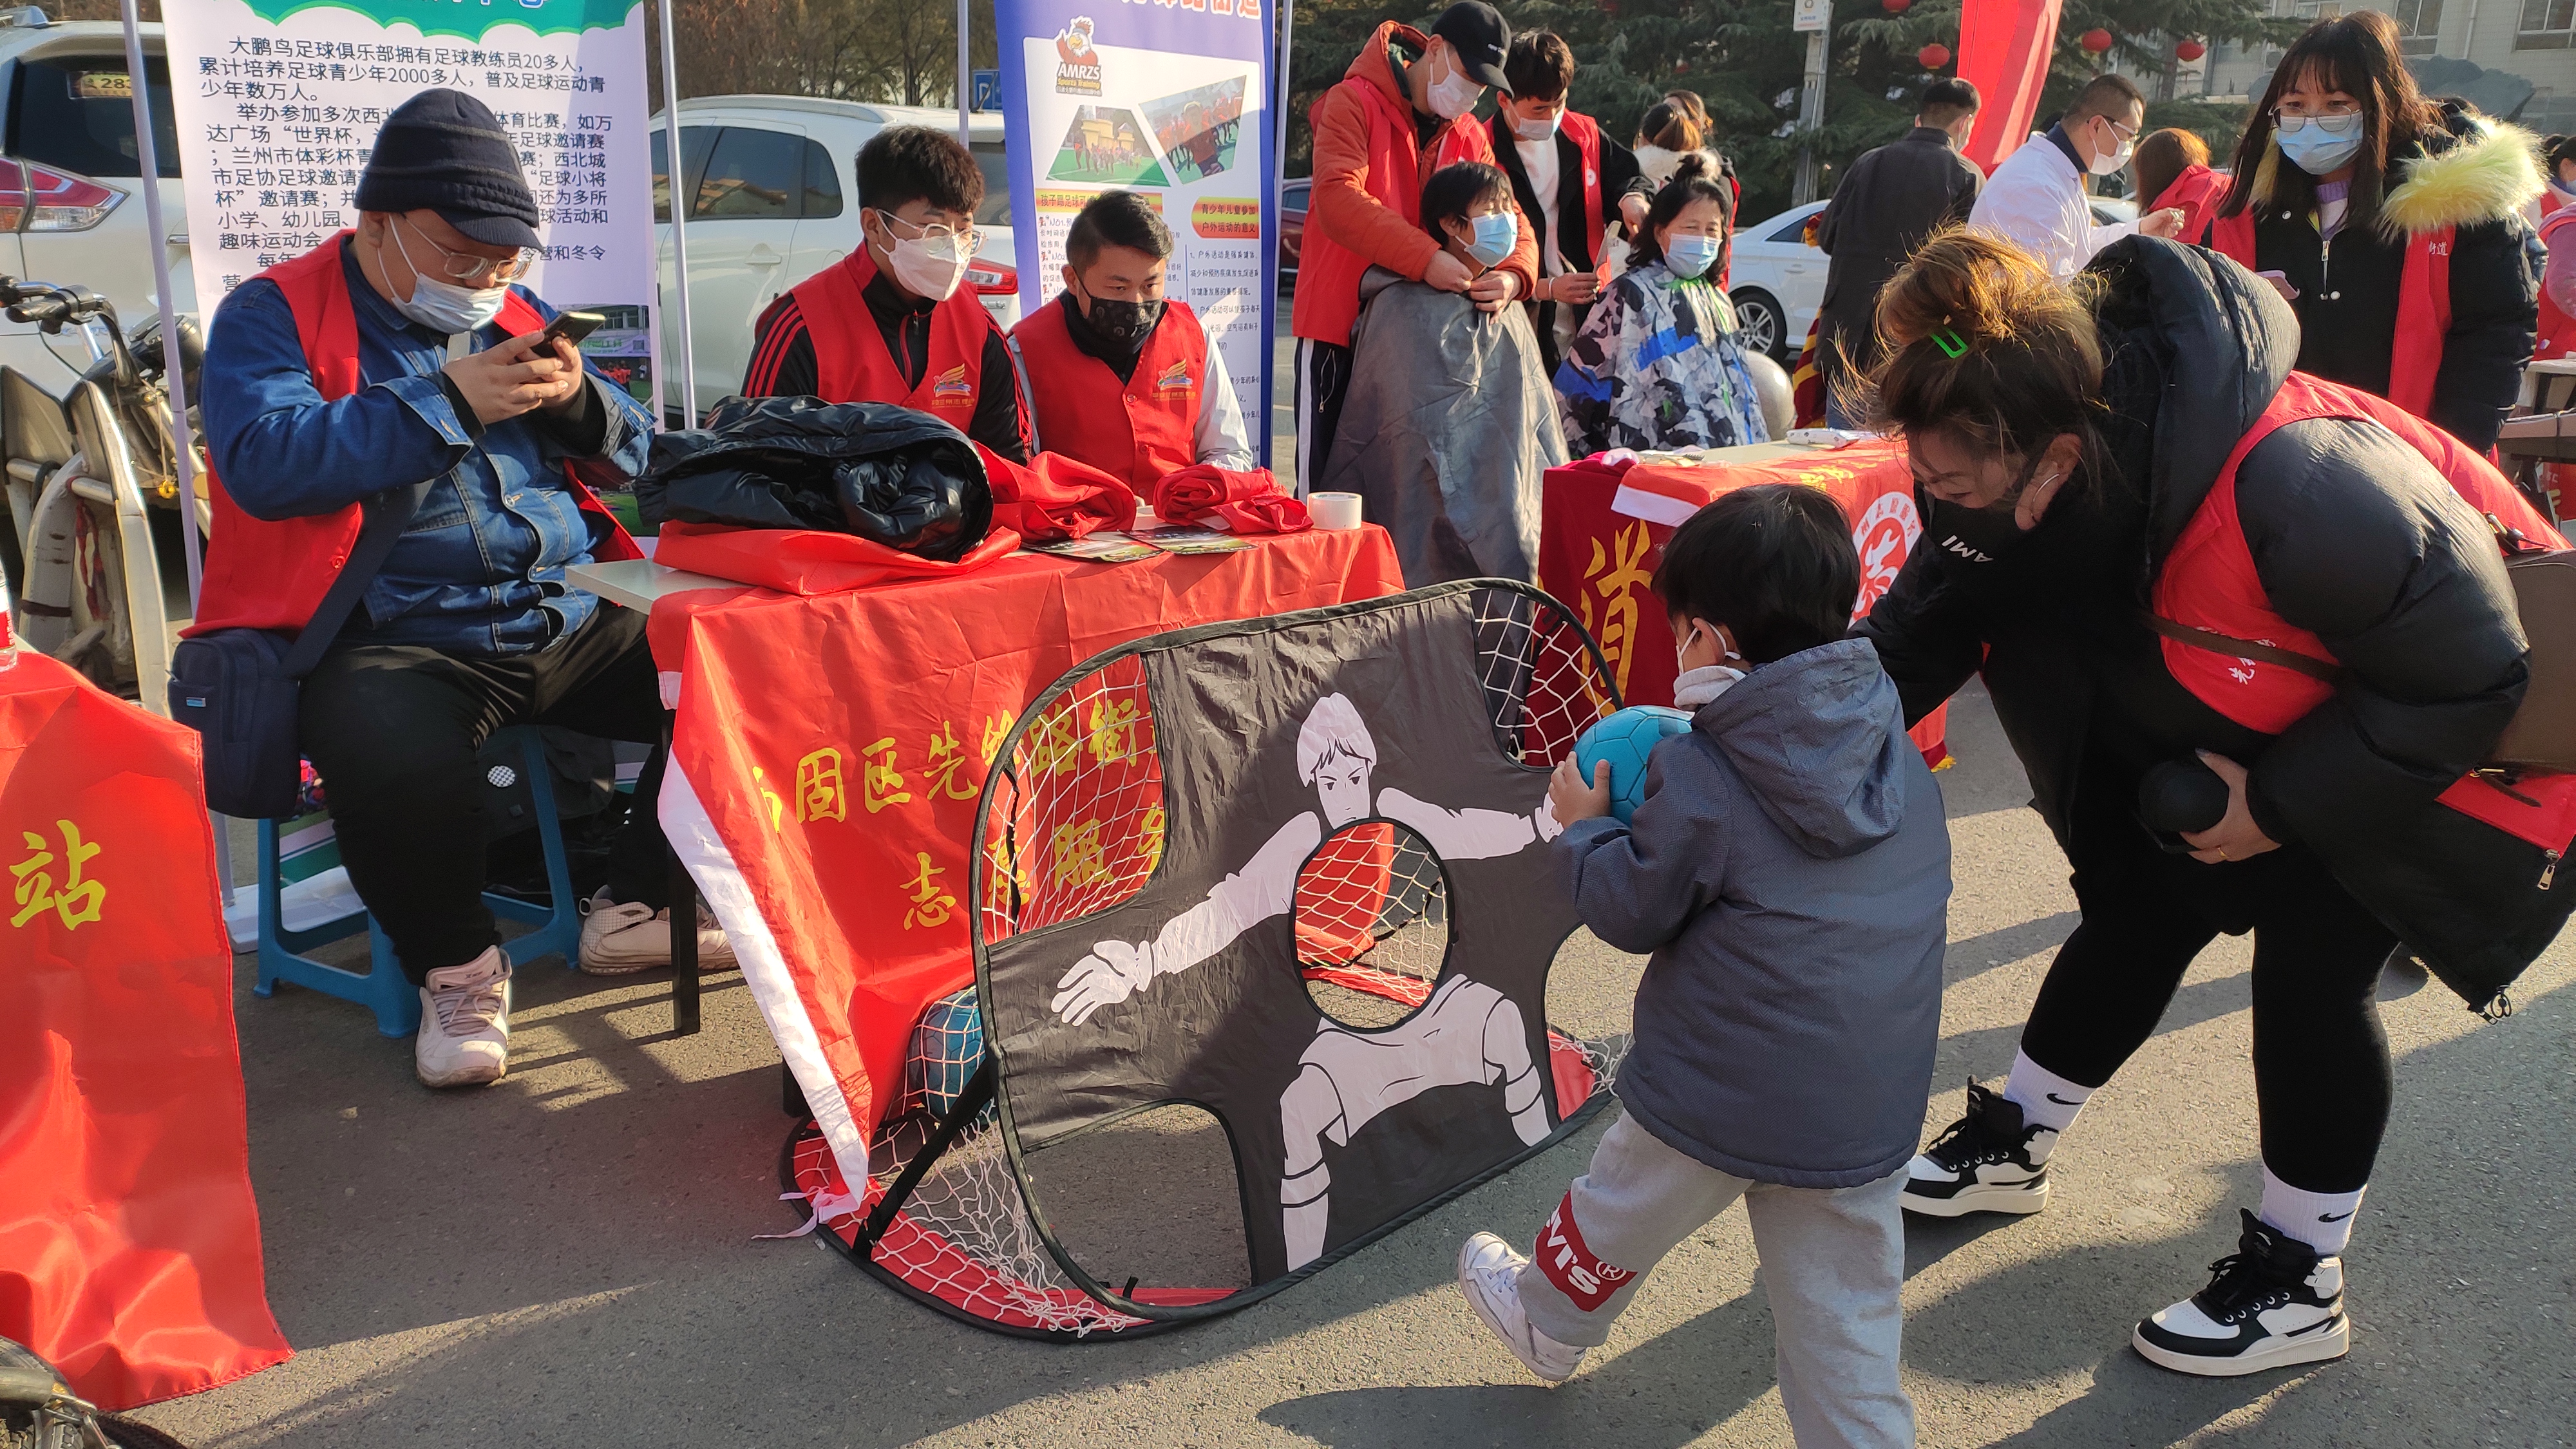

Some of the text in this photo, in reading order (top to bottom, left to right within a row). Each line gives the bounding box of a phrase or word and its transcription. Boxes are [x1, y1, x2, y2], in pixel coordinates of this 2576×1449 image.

[1057, 62, 1101, 80] AMRZS
[201, 79, 317, 102] 少年数万人。
[219, 231, 321, 250] 趣味运动会
[1580, 518, 1653, 718] 消
[8, 819, 106, 931] 站
